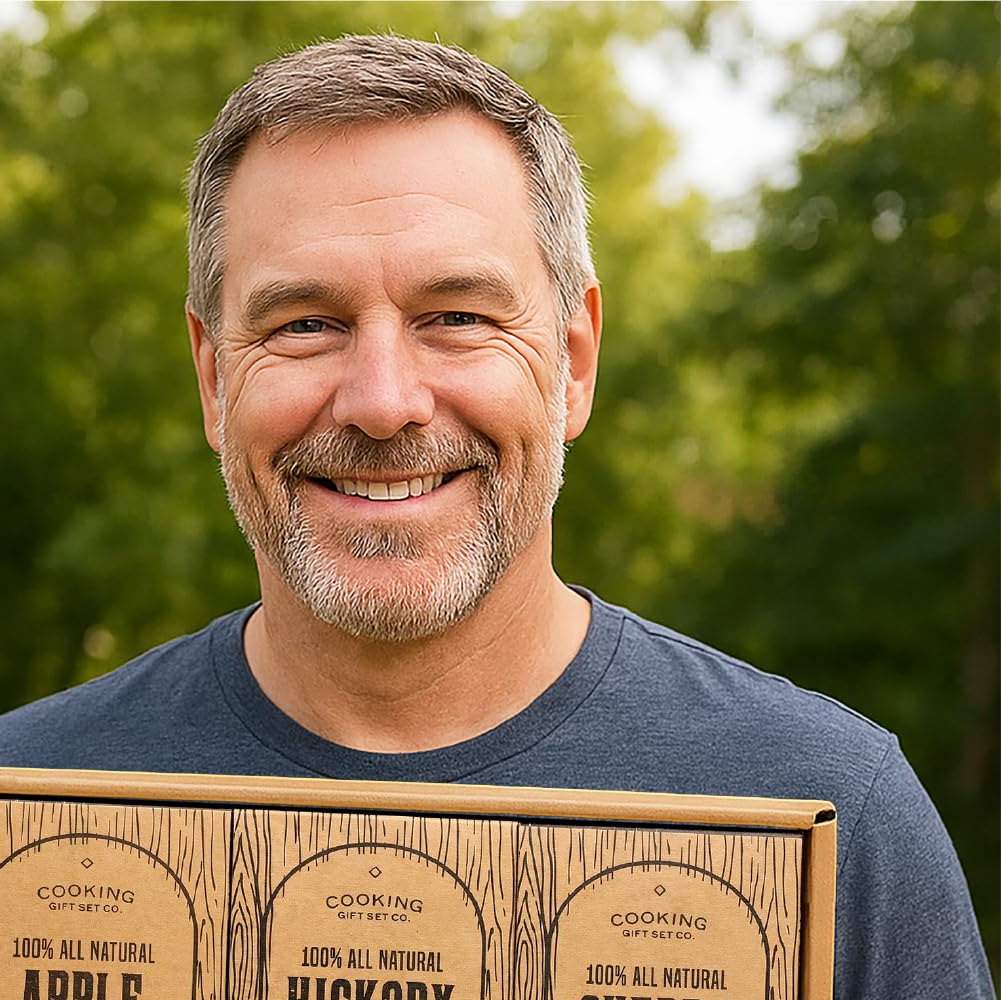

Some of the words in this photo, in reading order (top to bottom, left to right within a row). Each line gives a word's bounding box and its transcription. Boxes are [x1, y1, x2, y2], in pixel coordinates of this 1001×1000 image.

[37, 885, 134, 905] COOKING
[326, 894, 424, 913] COOKING
[48, 902, 76, 911] GIFT
[78, 904, 100, 913] SET
[102, 905, 123, 914] CO.
[337, 912, 364, 921] GIFT
[366, 913, 389, 921] SET
[391, 914, 411, 922] CO.
[610, 912, 708, 931] COOKING
[622, 930, 649, 938] GIFT
[651, 931, 673, 940] SET
[675, 932, 696, 940] CO.
[13, 938, 53, 959] 100%
[60, 940, 84, 960] ALL
[91, 941, 155, 963] NATURAL
[302, 947, 341, 968] 100%
[348, 949, 372, 969] ALL
[379, 950, 443, 972] NATURAL
[586, 964, 626, 986] 100%
[633, 967, 657, 987] ALL
[664, 968, 727, 990] NATURAL
